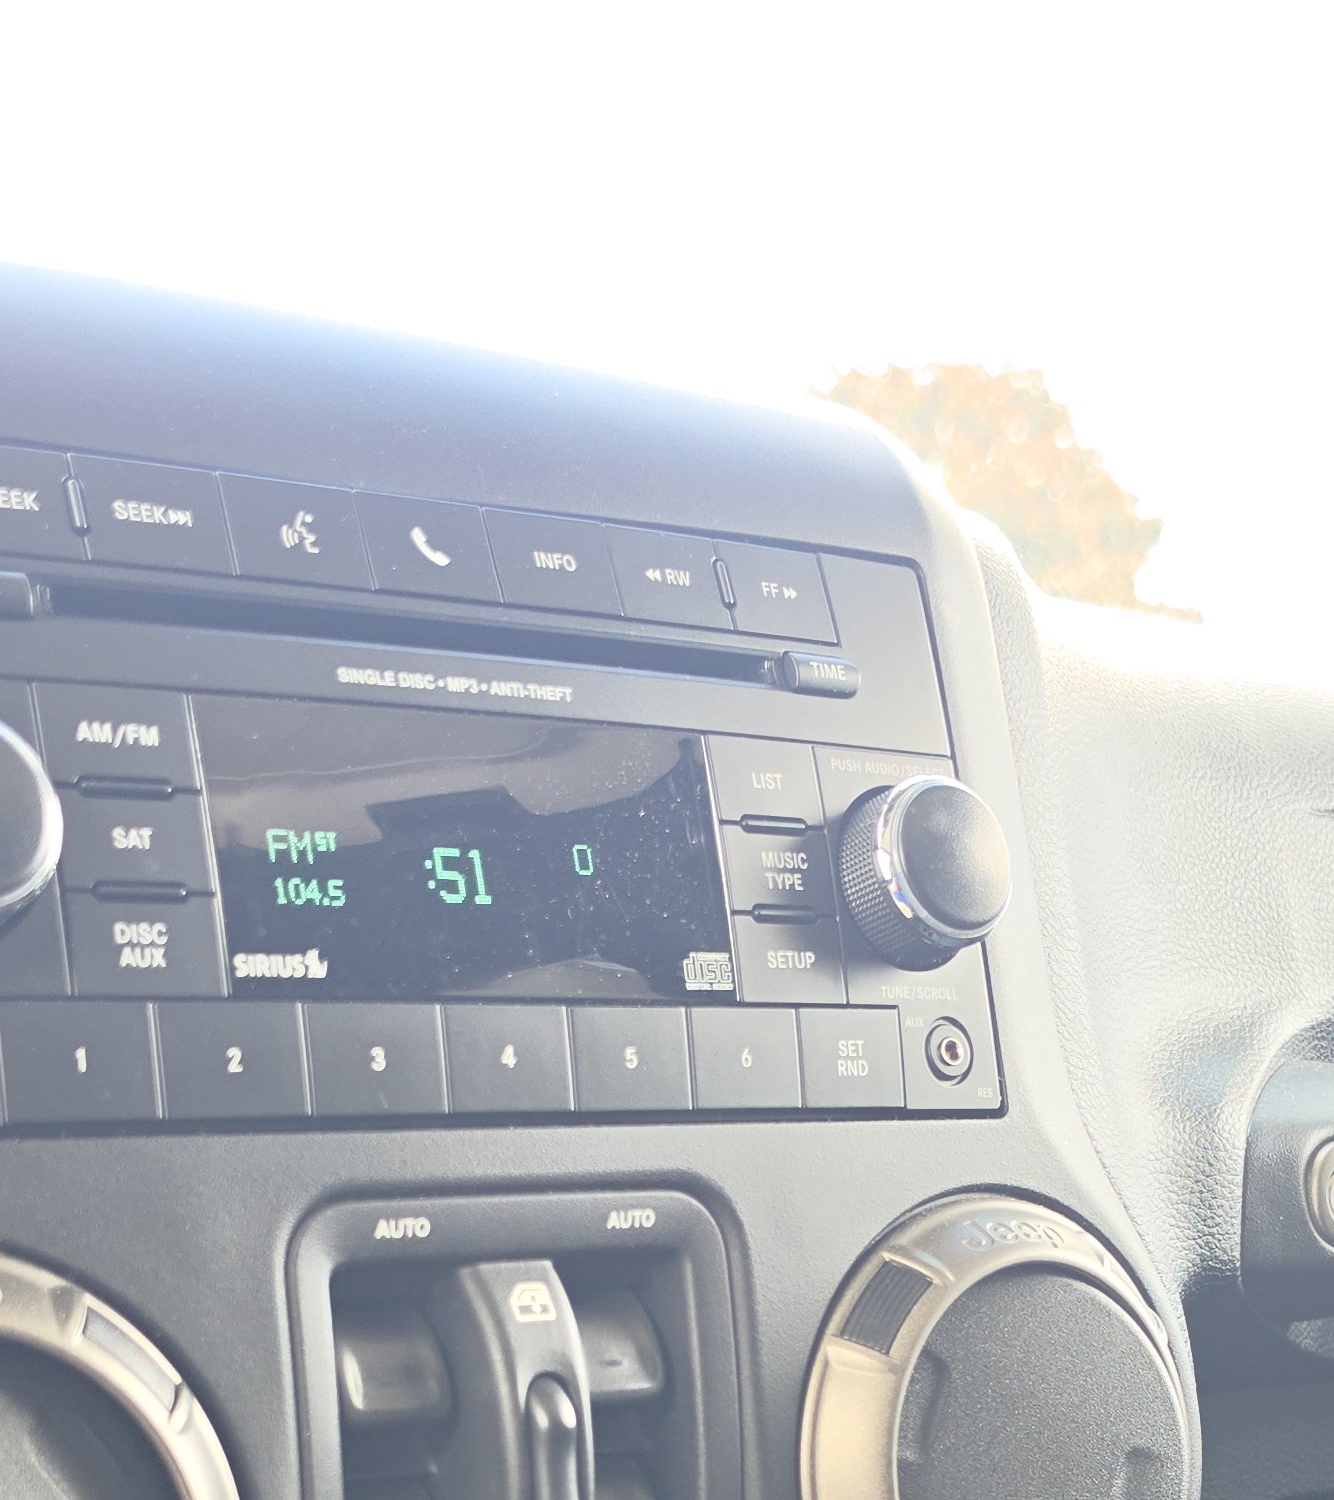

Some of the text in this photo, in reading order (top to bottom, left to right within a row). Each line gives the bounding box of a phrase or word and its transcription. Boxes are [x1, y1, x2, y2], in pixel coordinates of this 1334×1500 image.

[114, 500, 169, 526] SEEK
[533, 551, 578, 574] INFO
[665, 568, 691, 588] RW
[761, 581, 780, 599] FF
[810, 661, 847, 681] TIME
[336, 666, 574, 702] SINGLE DISC MP3 ANTI-THEFT
[76, 721, 160, 748] AM/FM
[830, 757, 862, 773] PUSH
[751, 772, 783, 790] LIST
[112, 827, 155, 850] SAT
[761, 851, 809, 870] MUSIC
[274, 877, 347, 908] 104.5
[766, 873, 804, 891] TYPE
[114, 922, 169, 945] DISC
[119, 947, 168, 969] AUX
[233, 953, 306, 979] SIRIUS
[767, 950, 816, 970] SETUP
[880, 985, 959, 1001] TUNE/SCROLL
[905, 1016, 926, 1029] AUX
[74, 1046, 88, 1073] 1
[225, 1046, 244, 1074] 2
[369, 1046, 388, 1072] 3
[499, 1045, 519, 1069] 4
[623, 1046, 639, 1070] 5
[740, 1047, 753, 1068] 6
[838, 1040, 865, 1057] SET
[837, 1060, 869, 1078] RND
[374, 1216, 431, 1240] AUTO
[606, 1208, 656, 1231] AUTO
